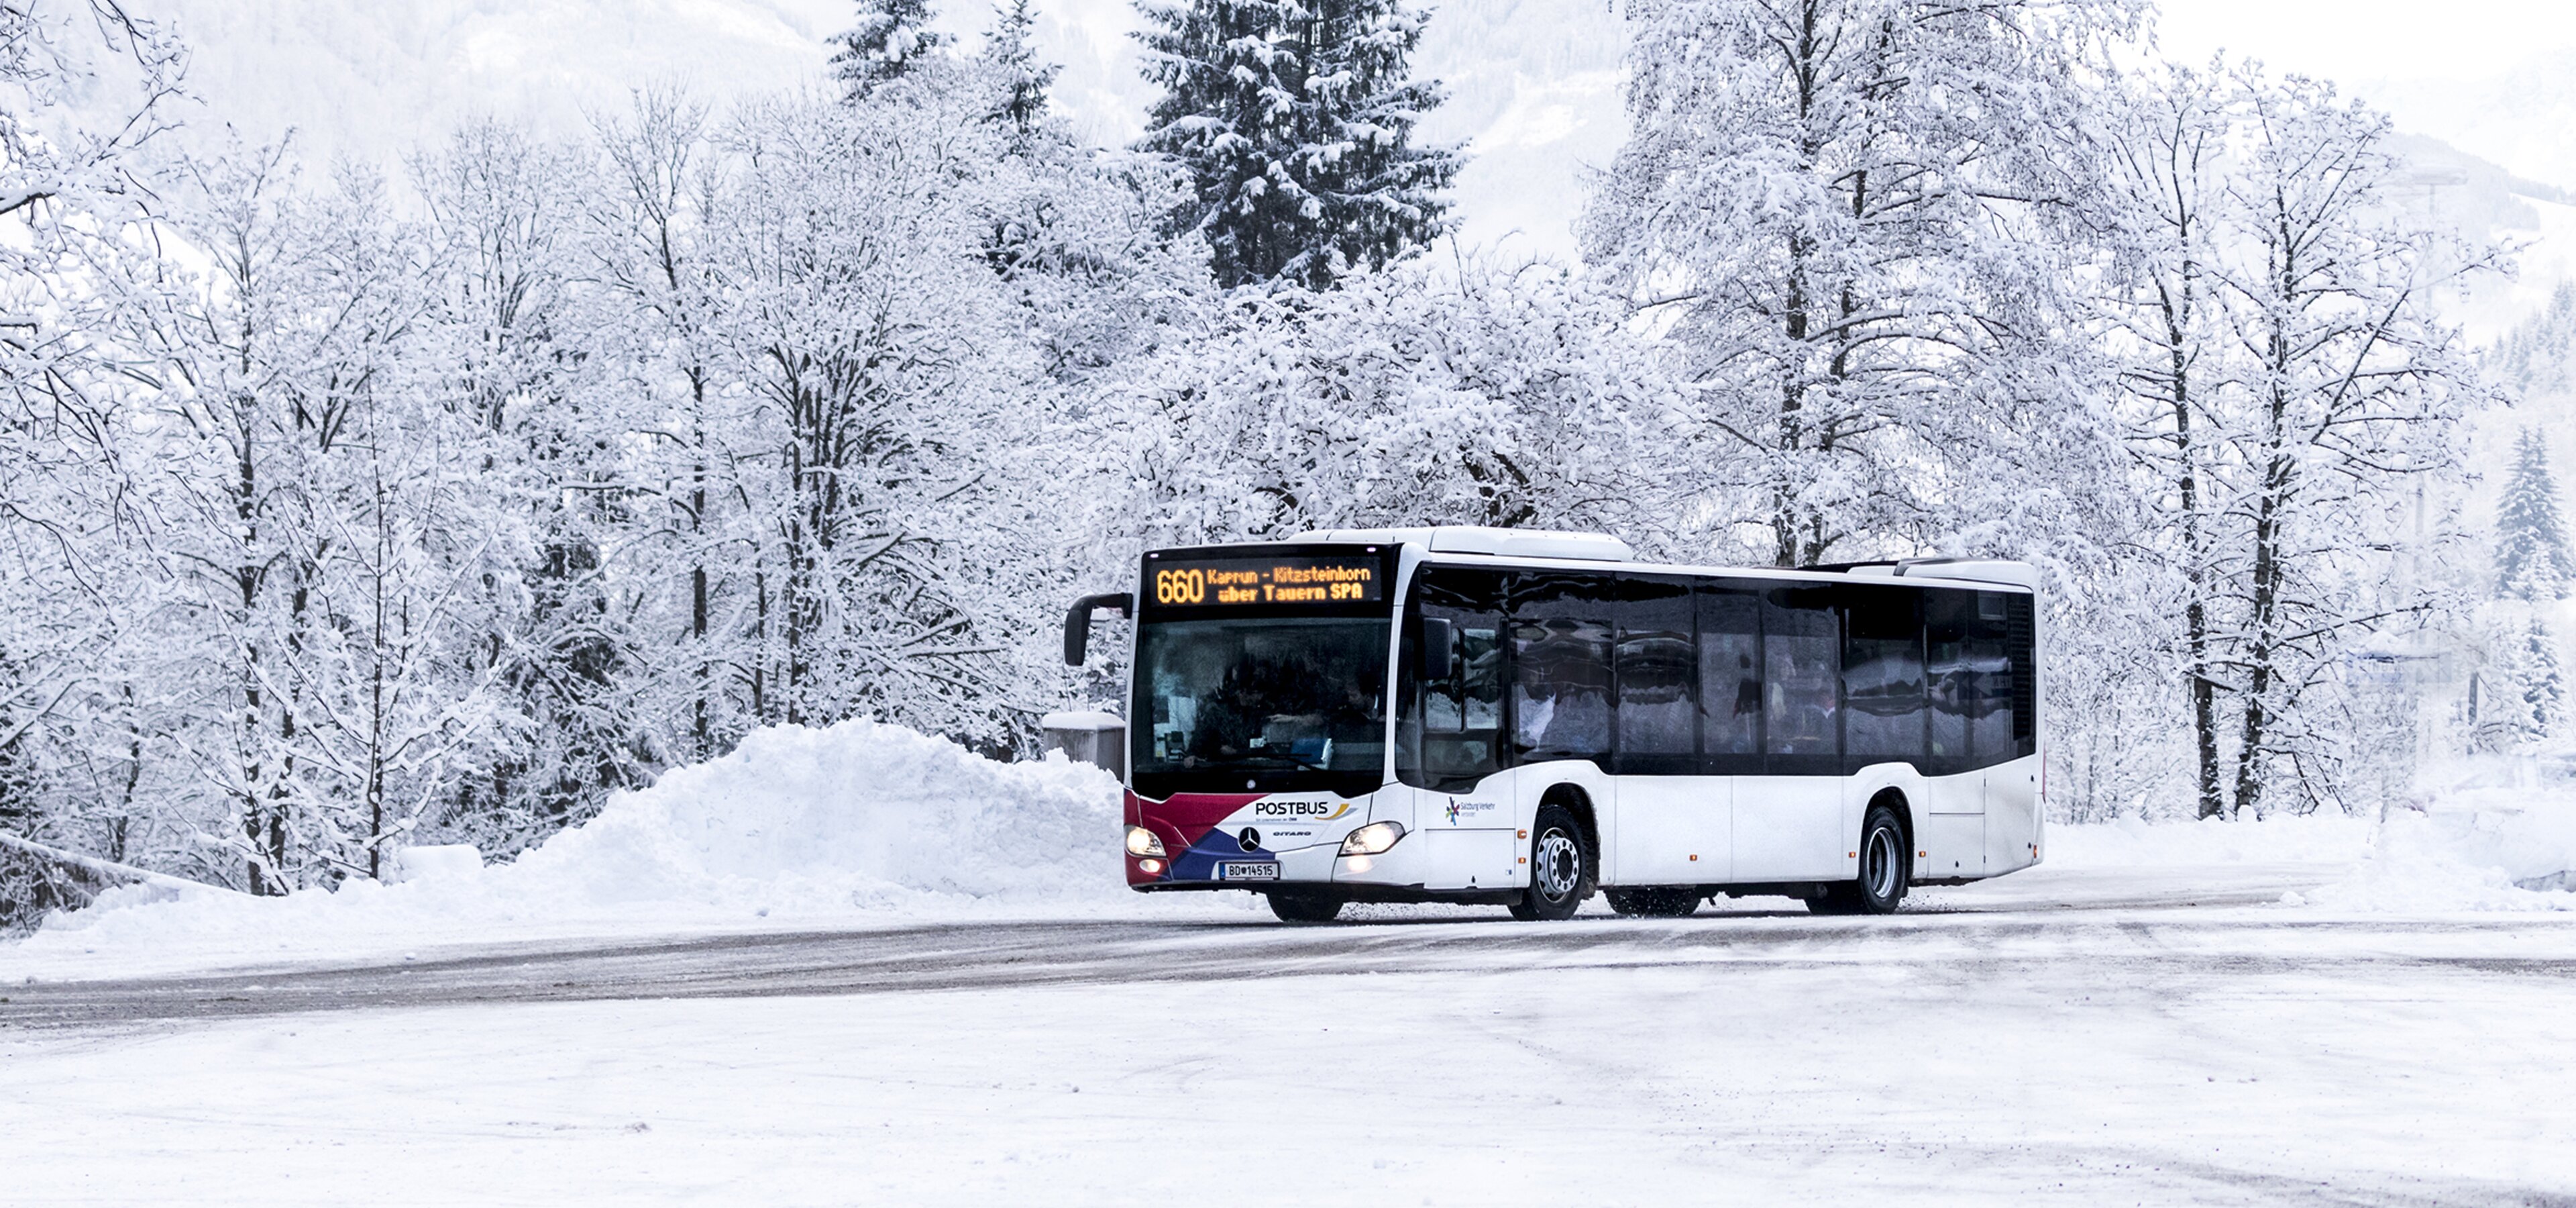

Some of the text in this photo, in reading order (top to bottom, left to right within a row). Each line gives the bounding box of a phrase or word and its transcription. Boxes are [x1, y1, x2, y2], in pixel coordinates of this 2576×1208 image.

[1207, 569, 1258, 584] Kaprun
[1273, 566, 1371, 583] Kitzsteinhorn
[1157, 569, 1204, 603] 660
[1218, 583, 1363, 602] über Tauern SPA
[1256, 801, 1328, 815] POSTBUS
